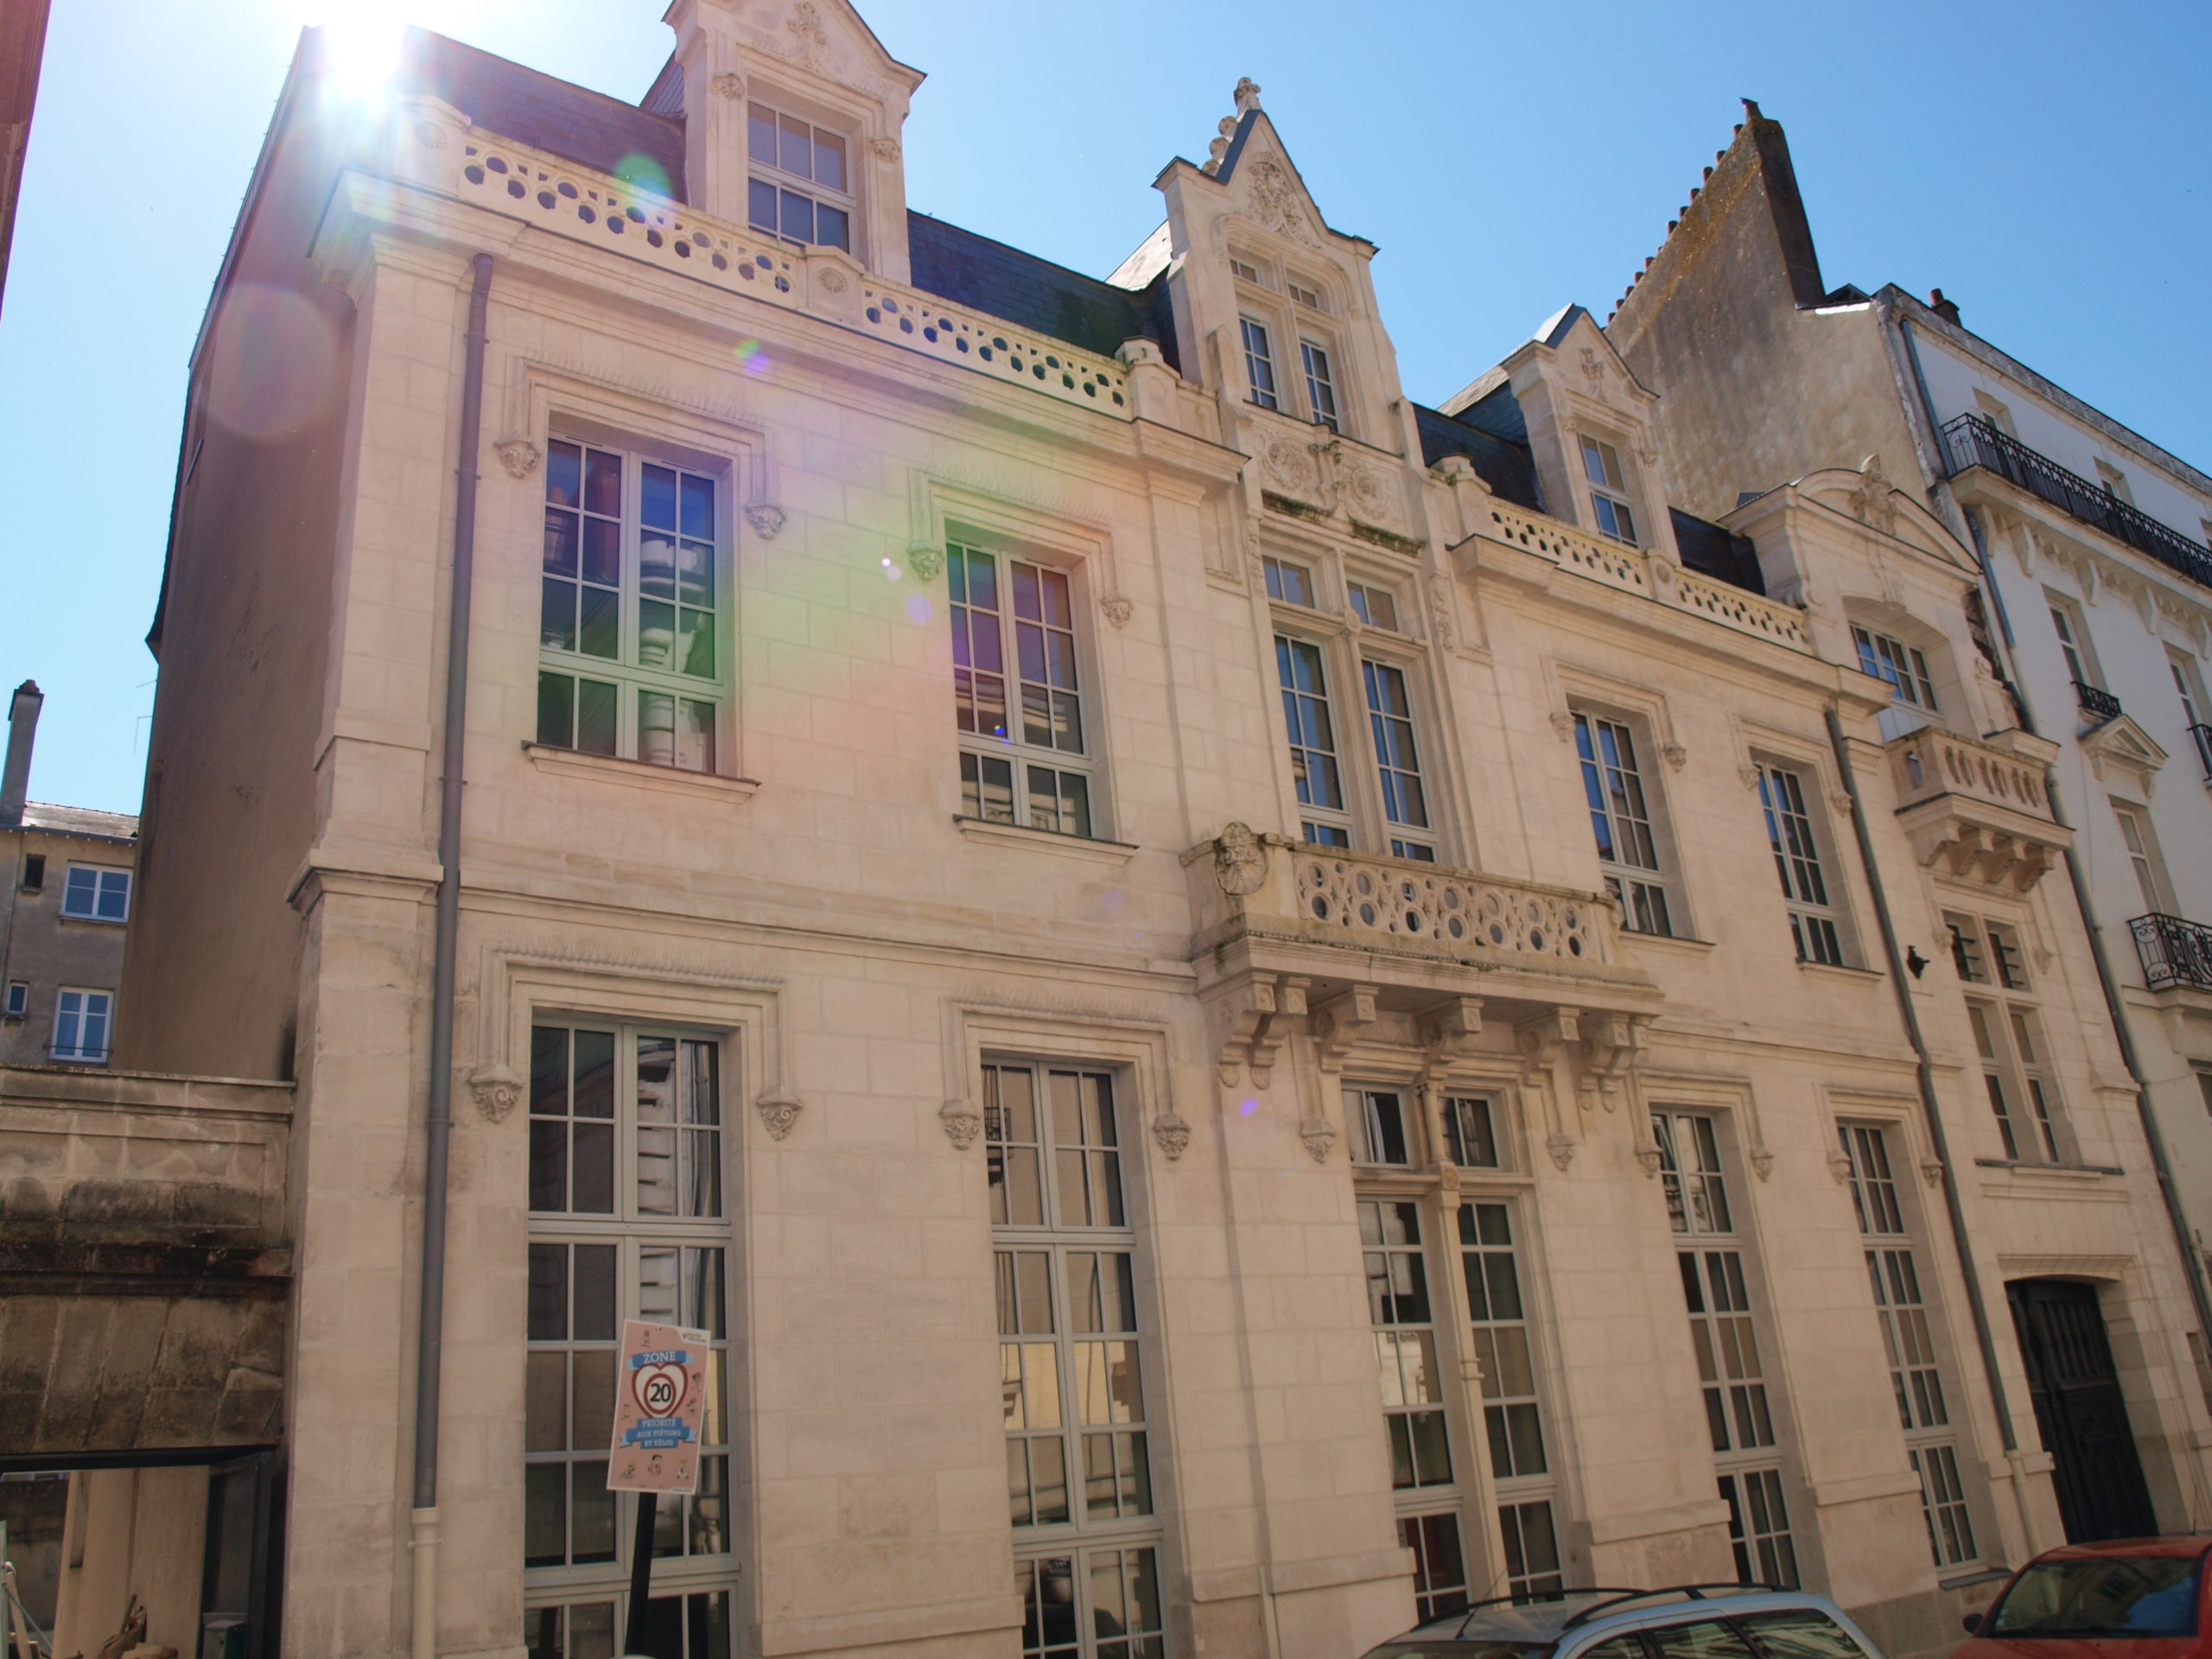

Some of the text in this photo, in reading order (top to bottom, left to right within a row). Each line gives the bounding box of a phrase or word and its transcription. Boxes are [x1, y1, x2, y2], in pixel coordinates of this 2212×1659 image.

[643, 1351, 676, 1363] ZONE
[650, 1382, 671, 1402] 20
[653, 1428, 681, 1437] PIÉTONS
